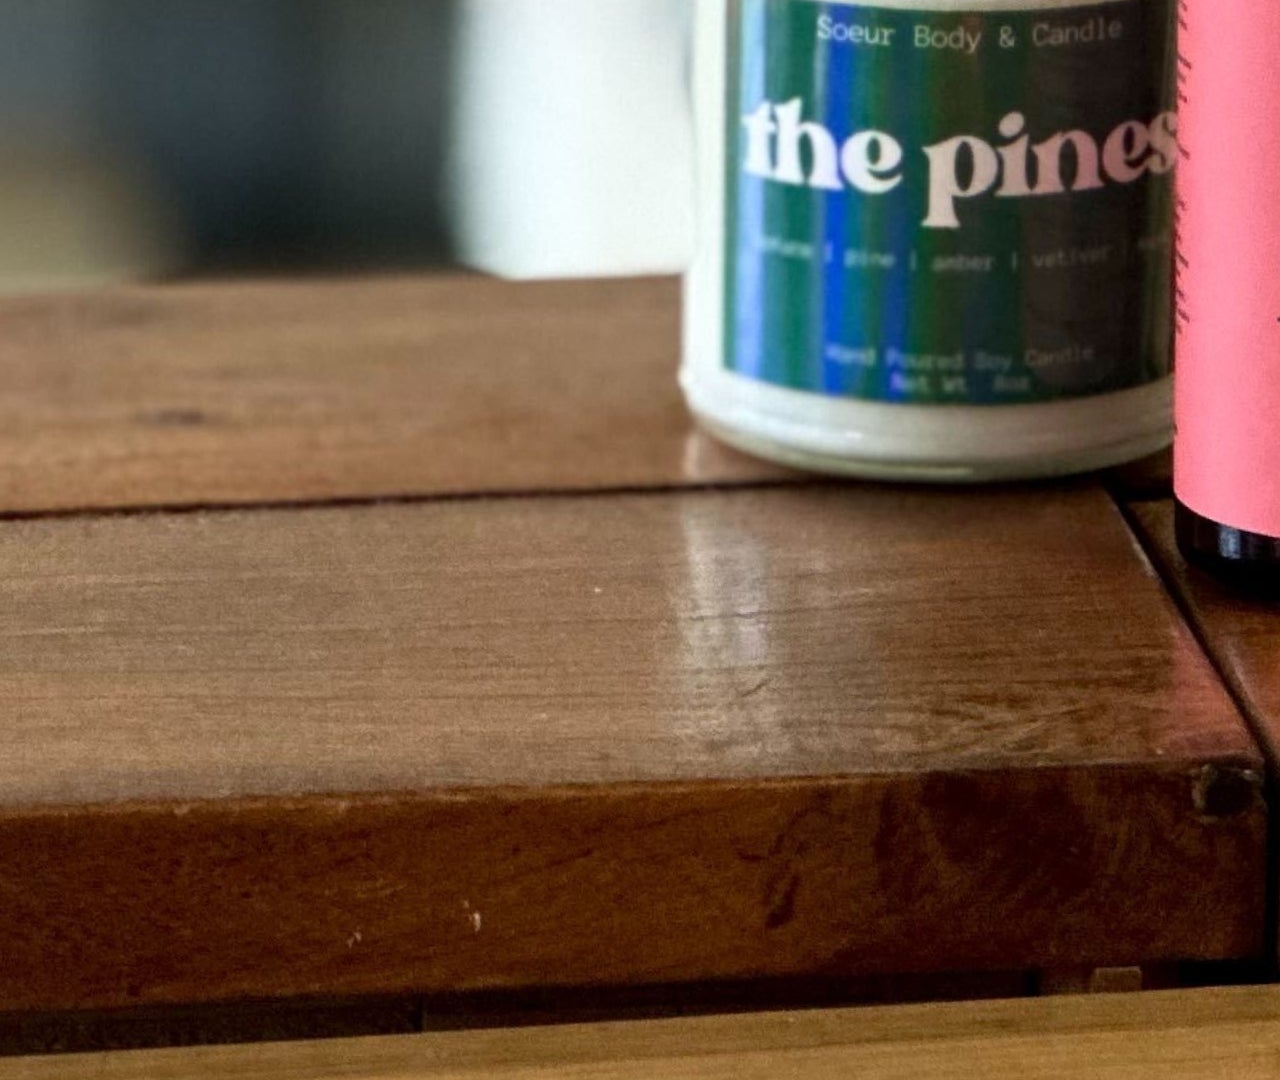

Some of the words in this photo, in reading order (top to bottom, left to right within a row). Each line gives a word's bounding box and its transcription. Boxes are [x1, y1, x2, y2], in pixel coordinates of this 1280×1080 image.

[817, 16, 895, 47] Soeur
[914, 24, 982, 54] Body
[999, 26, 1015, 47] &
[1032, 17, 1124, 48] Candle
[741, 97, 903, 194] the
[921, 110, 1179, 228] pines
